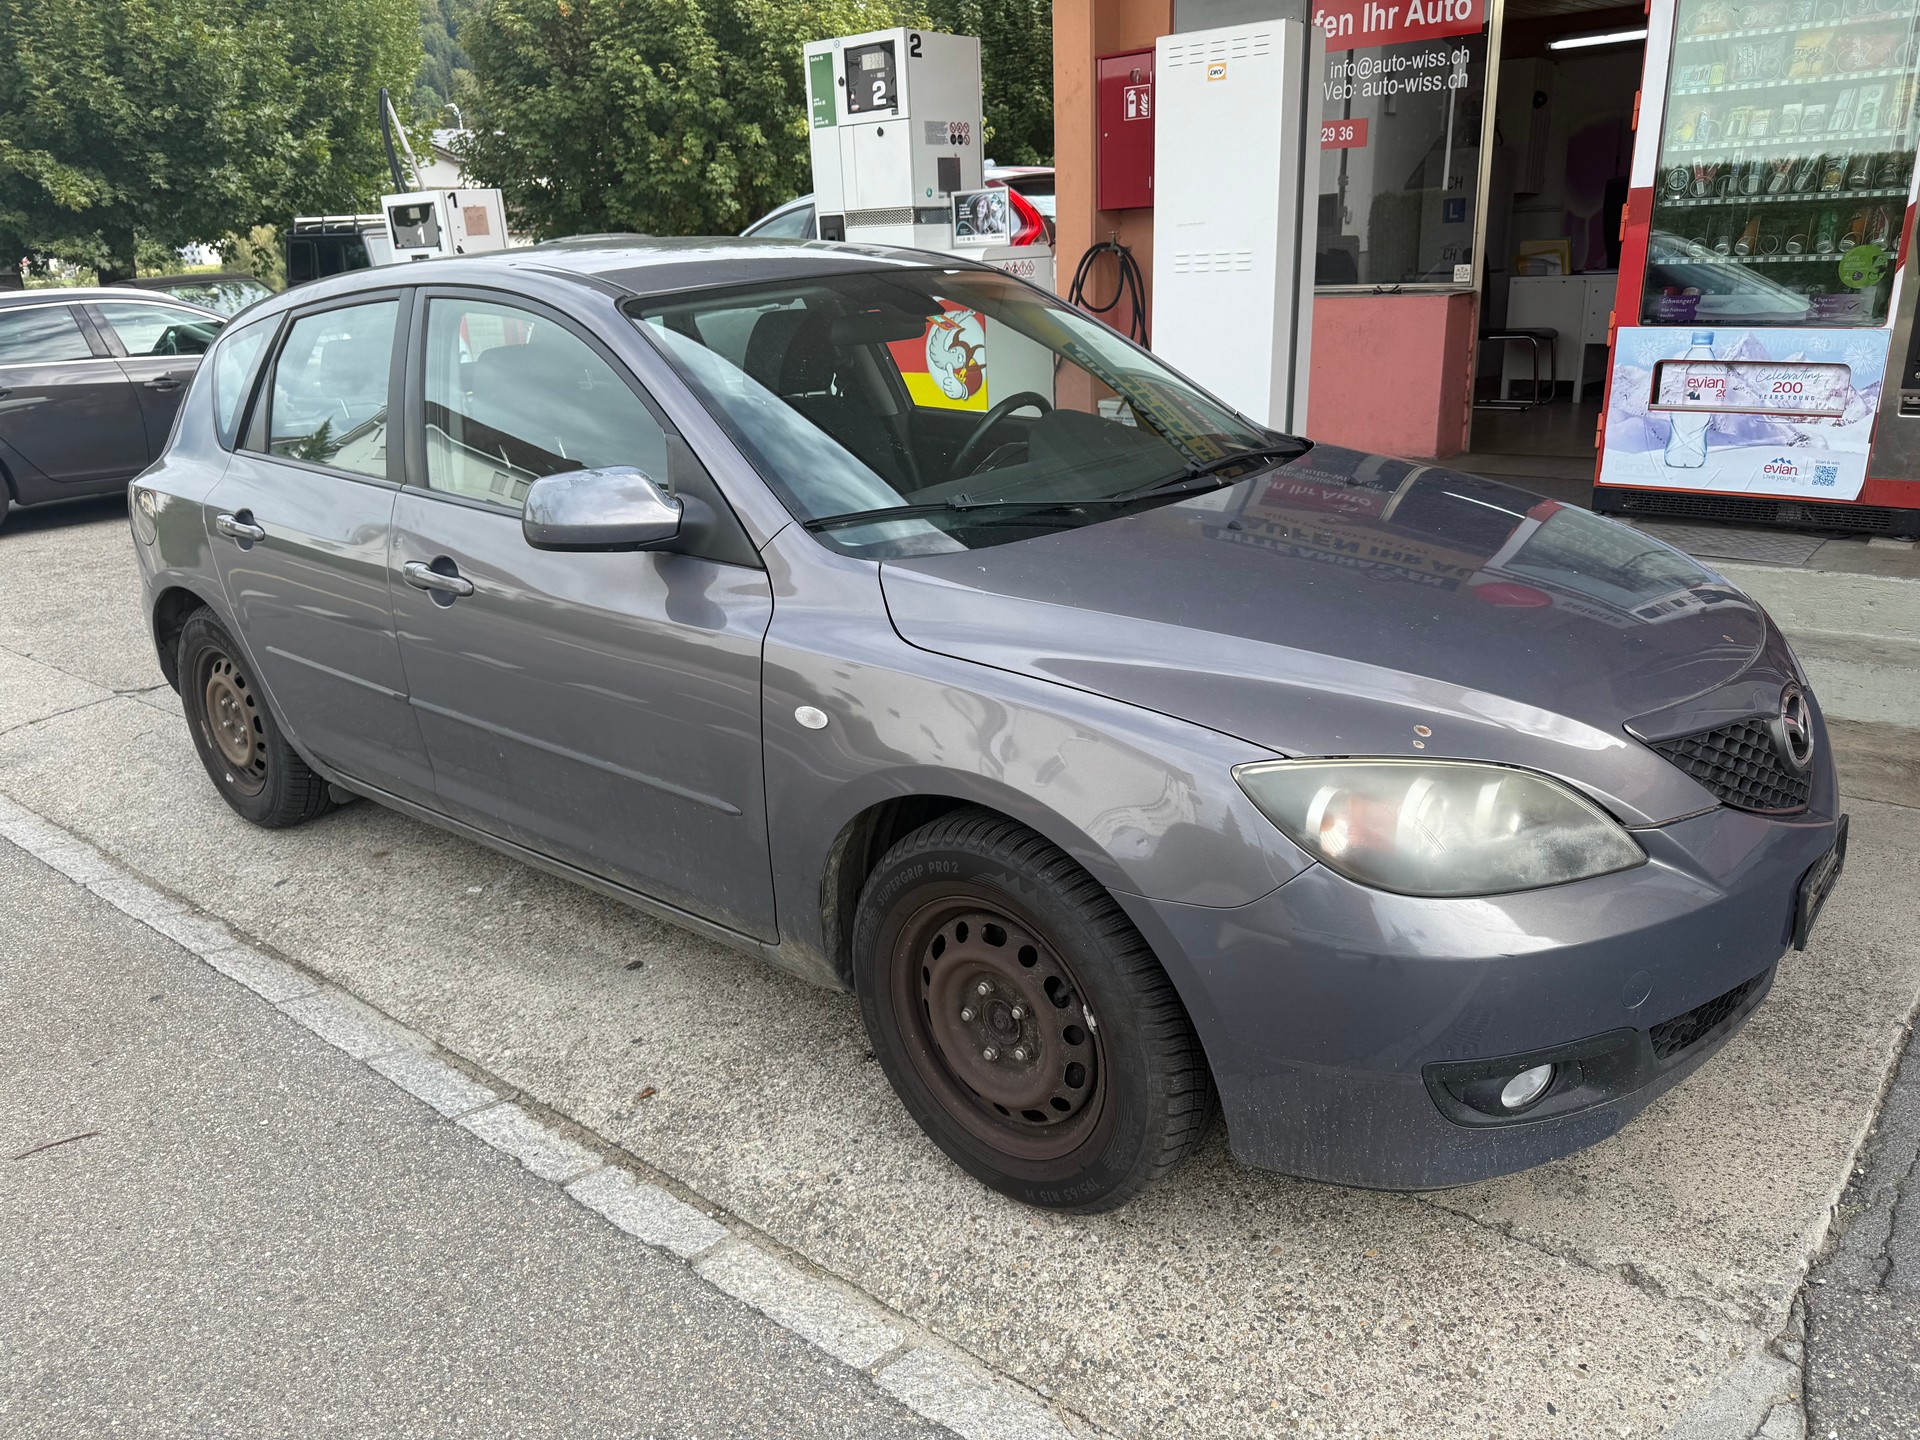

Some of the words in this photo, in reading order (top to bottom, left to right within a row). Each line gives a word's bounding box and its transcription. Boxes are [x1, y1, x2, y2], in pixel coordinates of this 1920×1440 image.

[1363, 2, 1399, 33] Ihr
[1404, 0, 1473, 28] Auto
[909, 33, 923, 58] 2
[1330, 45, 1470, 79] info@auto-wiss.ch
[1209, 68, 1224, 77] DKV
[1362, 68, 1469, 97] auto-wiss.ch
[872, 80, 887, 106] 2
[1321, 127, 1336, 142] 29
[1338, 126, 1354, 141] 36
[447, 192, 457, 208] 1
[1449, 202, 1459, 219] L
[417, 226, 425, 244] 1
[1661, 297, 1696, 306] Schwanger?
[1755, 367, 1824, 385] Celebrating
[1772, 381, 1803, 394] 200
[1776, 475, 1797, 483] young
[877, 863, 924, 906] SUPERGRIP
